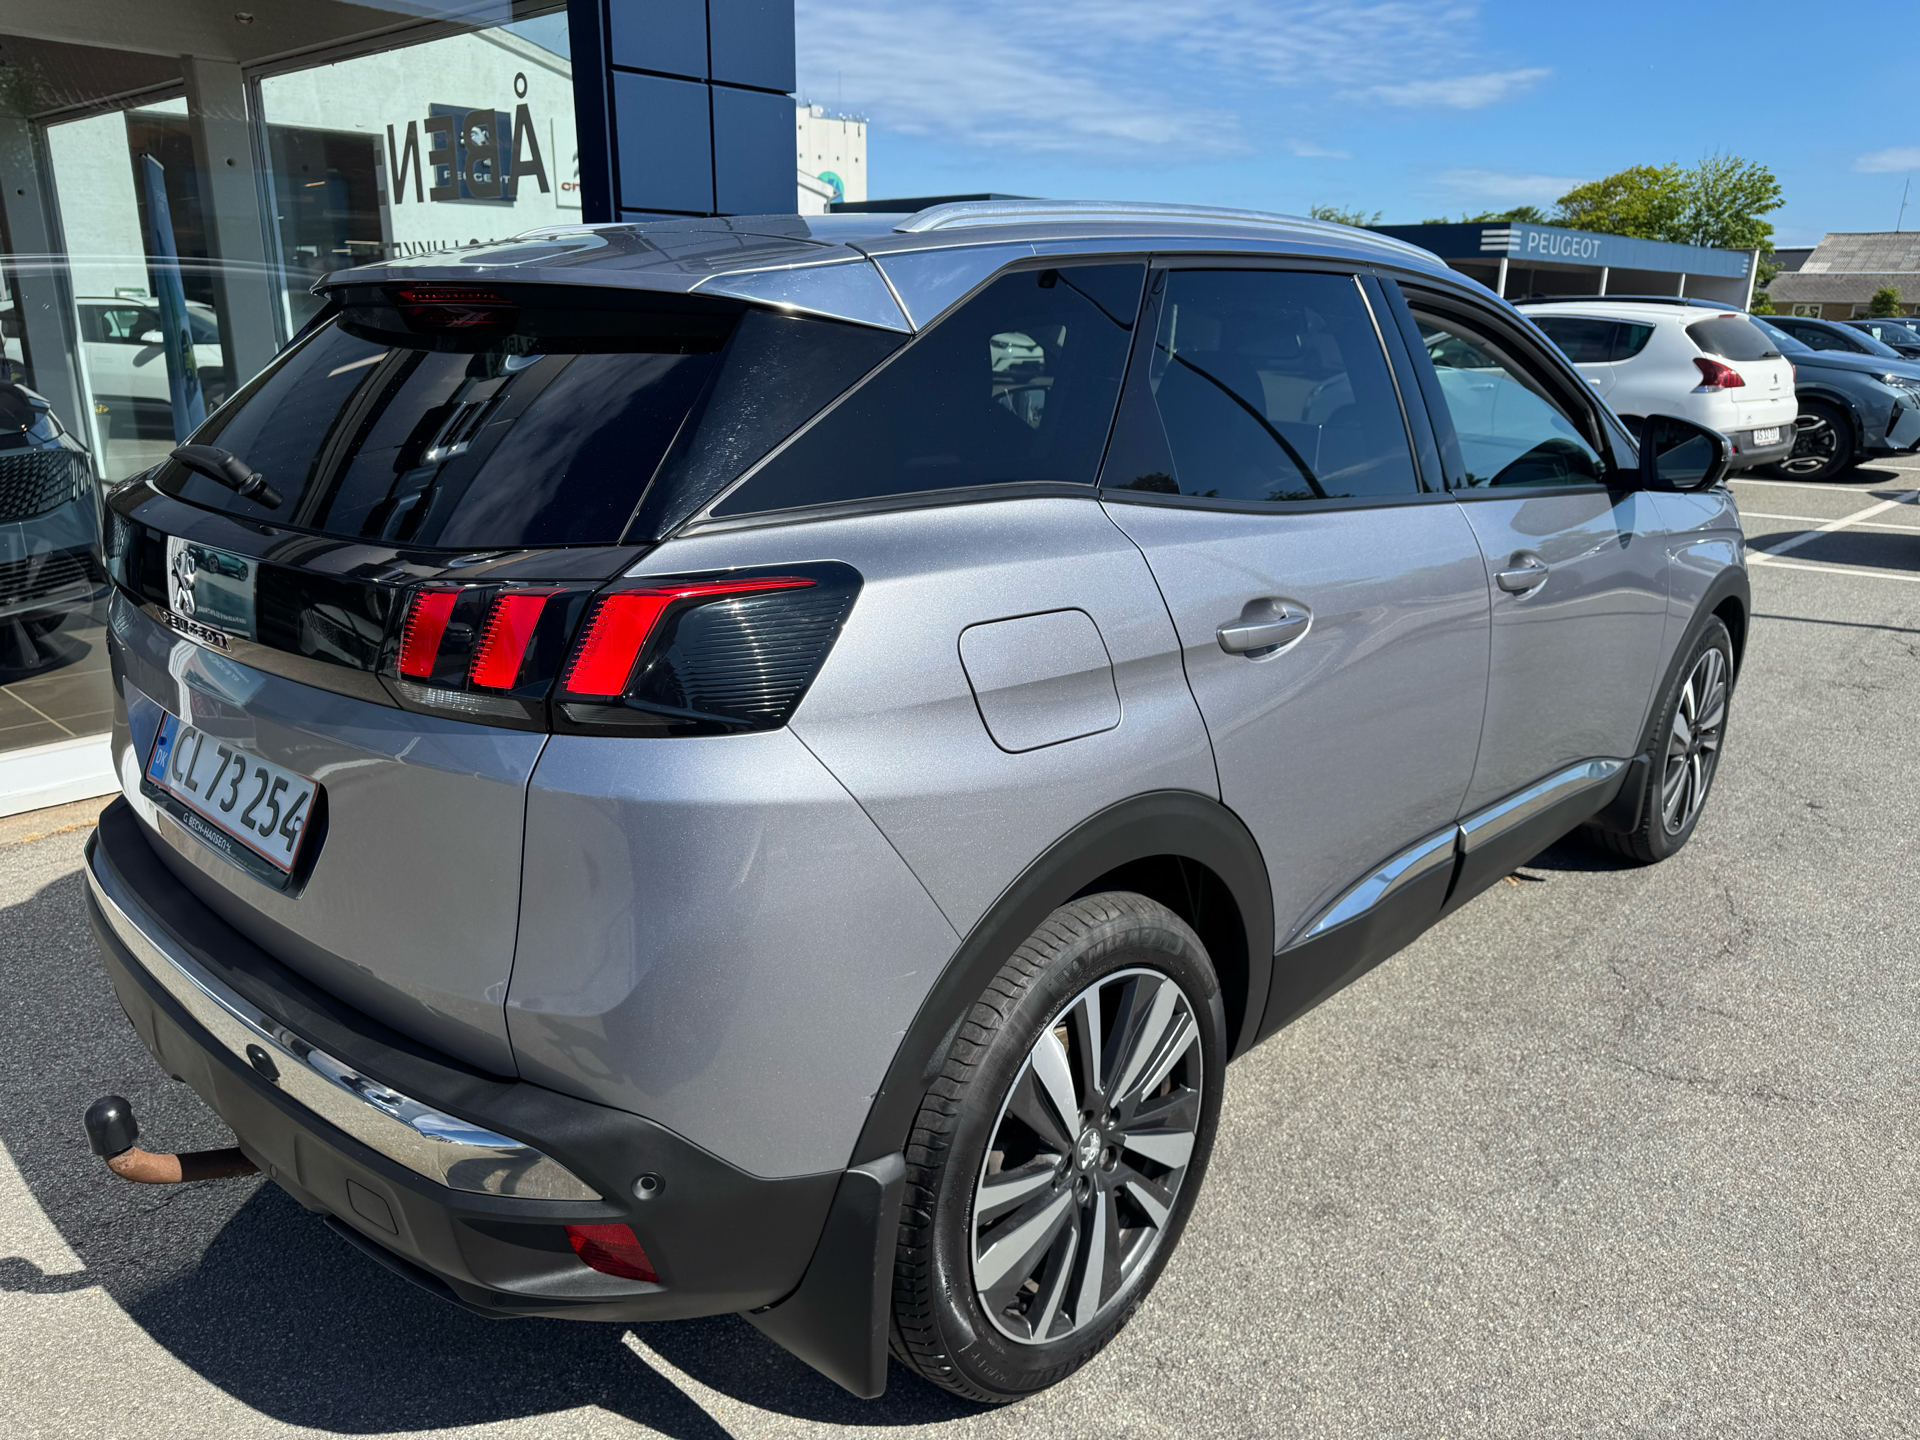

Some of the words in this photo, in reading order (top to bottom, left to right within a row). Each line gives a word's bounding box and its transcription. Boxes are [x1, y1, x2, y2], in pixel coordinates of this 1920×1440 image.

[1528, 232, 1601, 259] PEUGEOT
[163, 610, 224, 647] PEUGEOT
[155, 748, 169, 768] DK
[171, 726, 204, 793] CL
[204, 743, 247, 813] 73
[240, 766, 309, 853] 254
